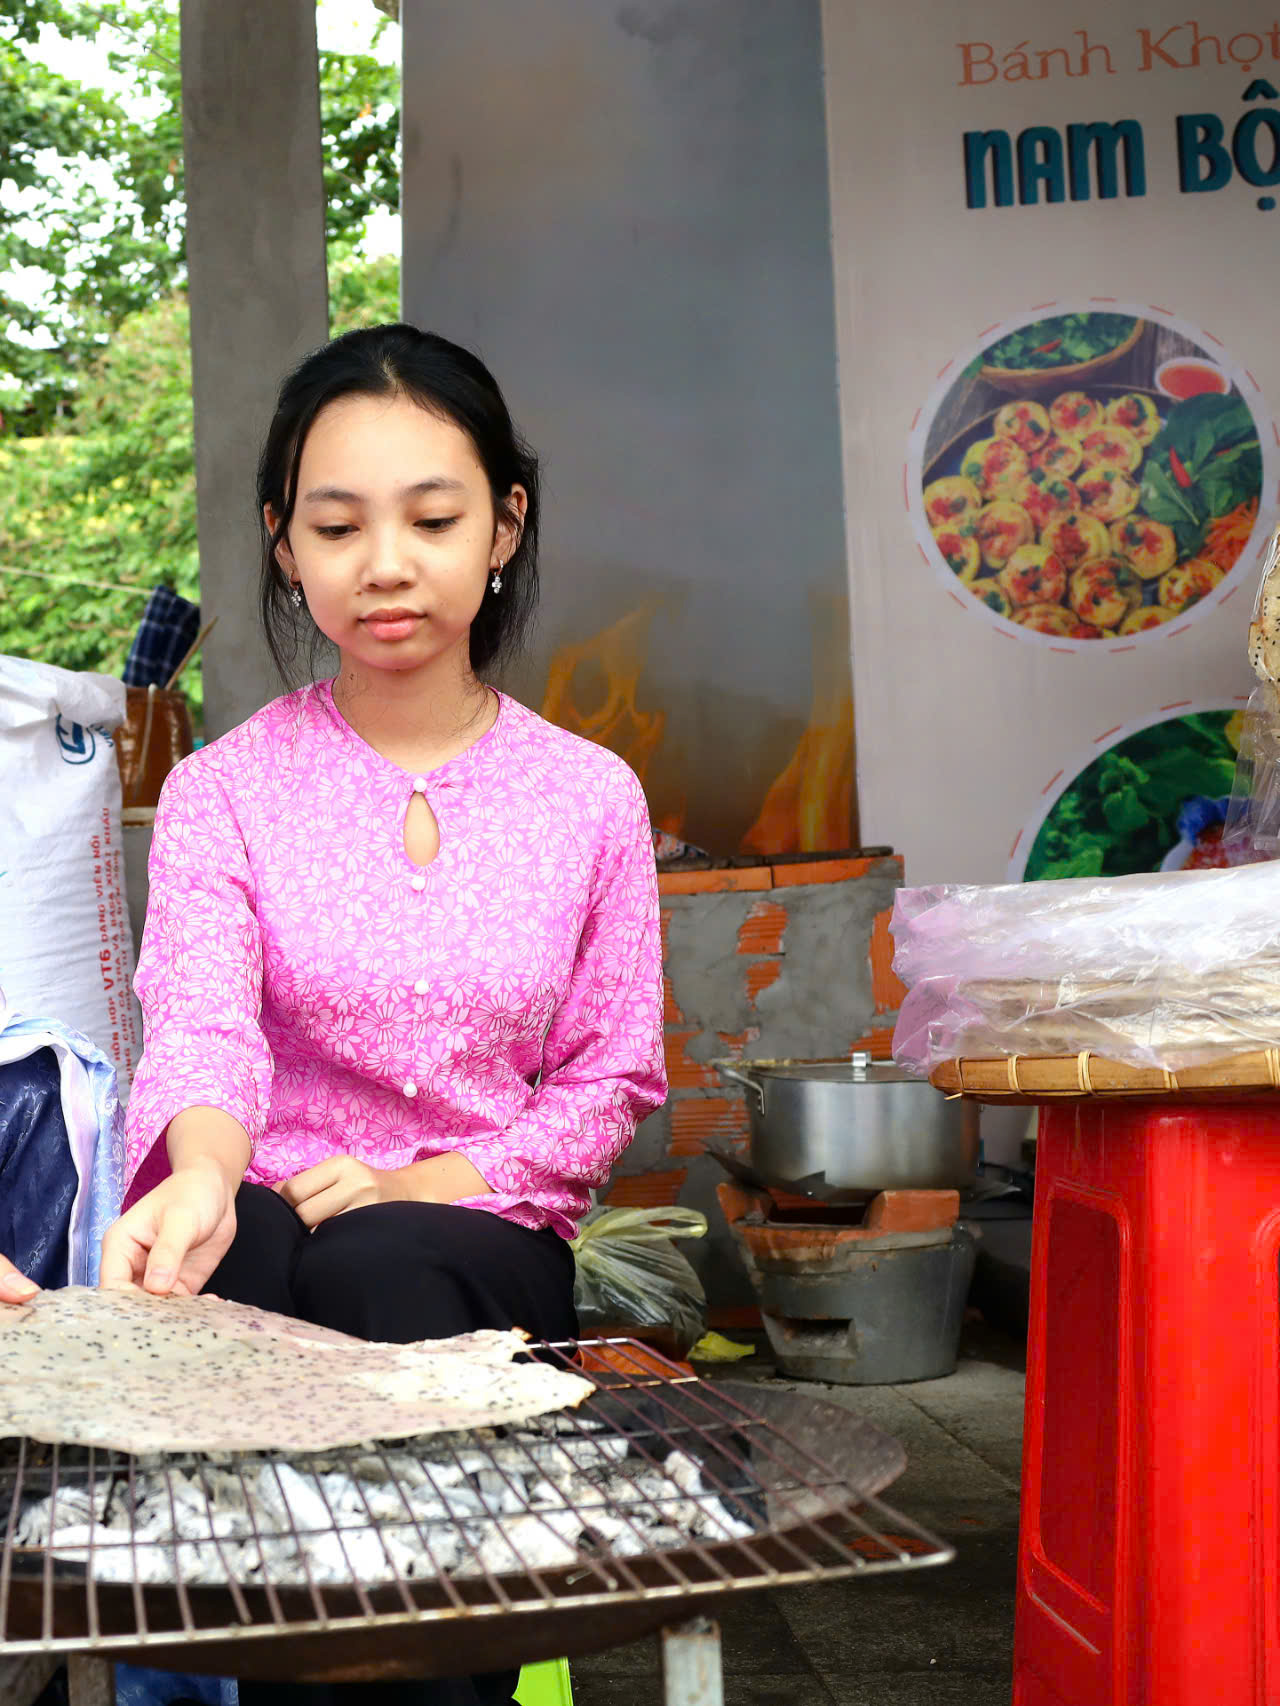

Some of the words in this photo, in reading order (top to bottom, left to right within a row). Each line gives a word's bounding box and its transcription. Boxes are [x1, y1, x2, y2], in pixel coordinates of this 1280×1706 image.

[956, 30, 1117, 87] Bánh
[1136, 20, 1280, 73] Khọt
[963, 119, 1147, 209] NAM
[1176, 79, 1280, 211] BỘ
[99, 949, 115, 991] VT6
